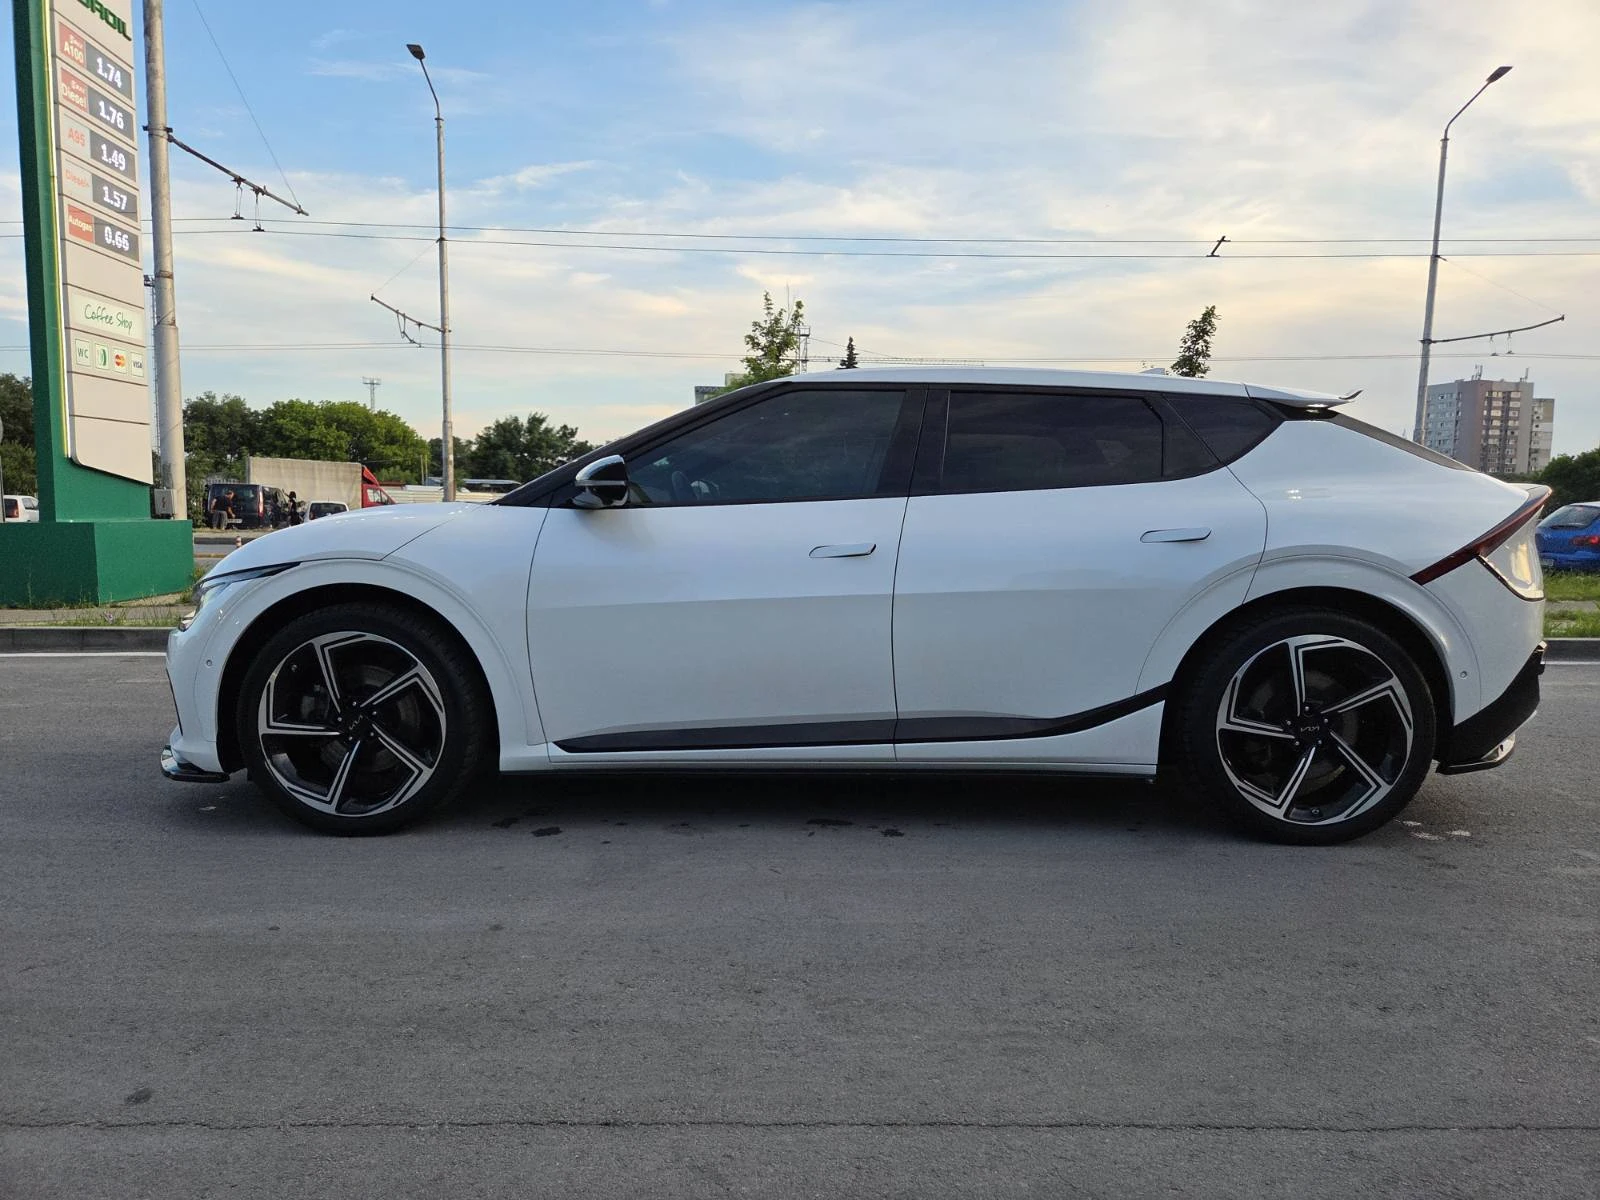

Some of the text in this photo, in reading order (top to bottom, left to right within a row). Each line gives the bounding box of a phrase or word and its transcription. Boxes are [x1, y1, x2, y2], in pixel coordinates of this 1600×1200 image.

[77, 0, 132, 41] ROIL
[63, 41, 84, 64] A100
[96, 57, 122, 88] 1.74
[61, 83, 87, 106] Diesel
[98, 100, 124, 130] 1.76
[68, 127, 86, 147] A95
[100, 143, 126, 171] 1.49
[102, 186, 128, 210] 1.57
[68, 215, 93, 233] Autogas
[104, 226, 130, 251] 0.66
[84, 304, 133, 336] Coffee Shop
[77, 348, 89, 359] WC
